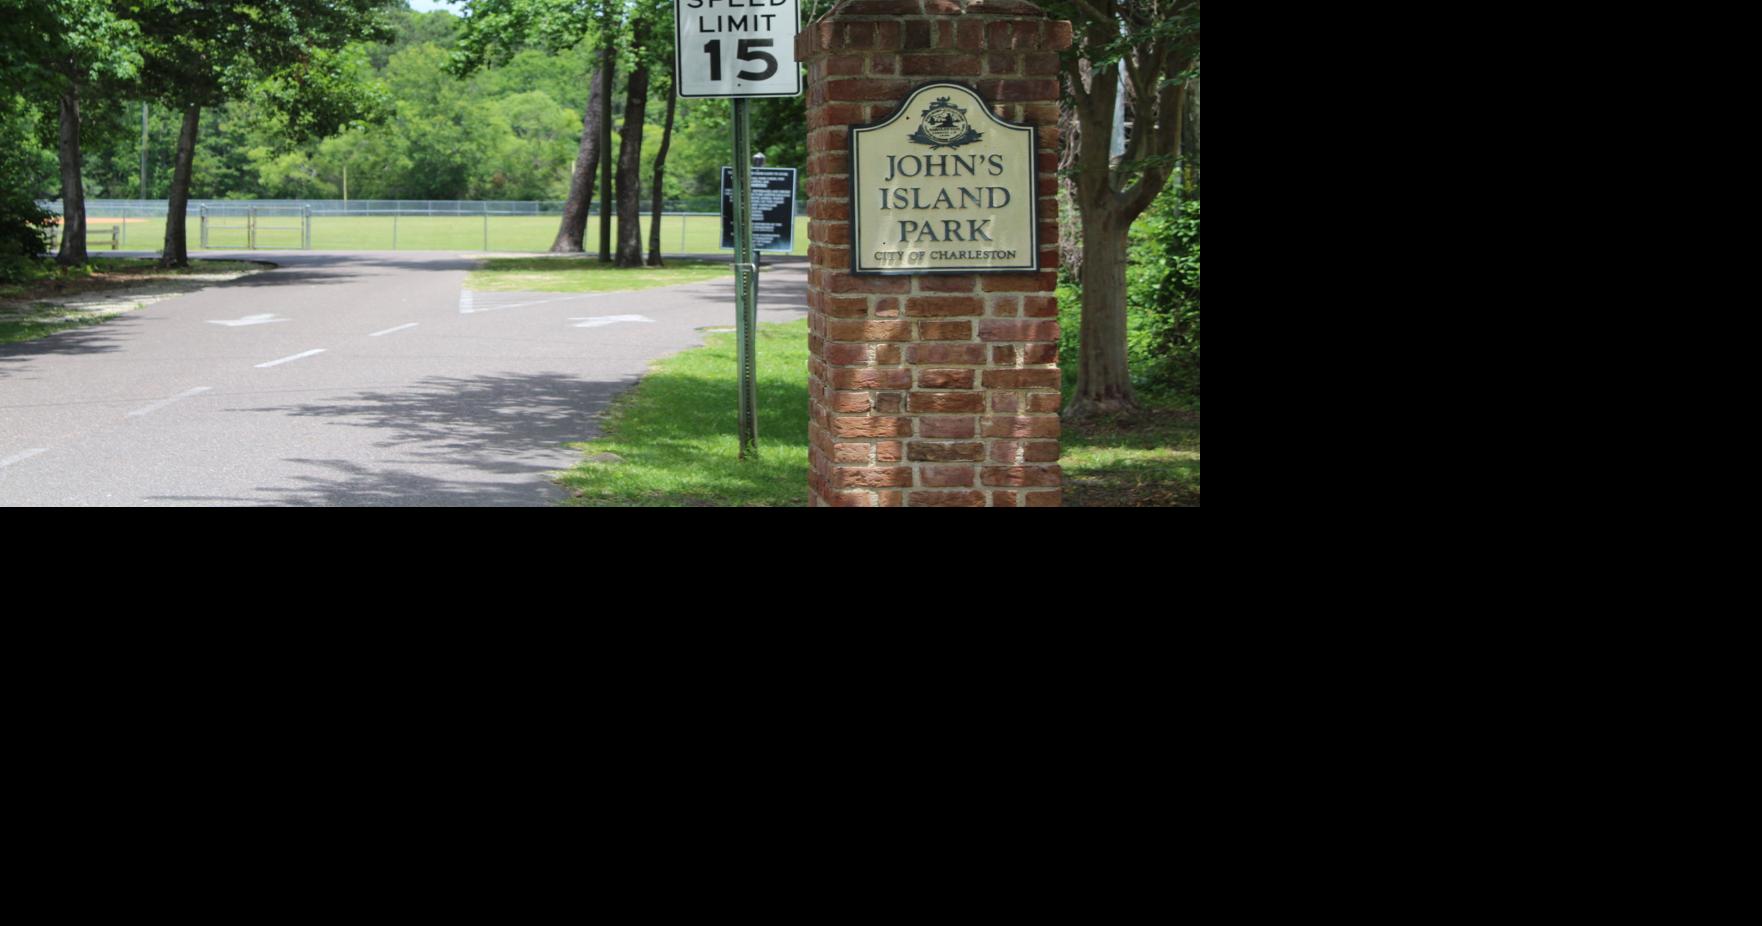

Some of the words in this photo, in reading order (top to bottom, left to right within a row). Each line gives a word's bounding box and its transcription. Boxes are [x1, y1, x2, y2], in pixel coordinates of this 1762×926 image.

[699, 14, 776, 33] LIMIT
[704, 38, 778, 81] 15
[884, 154, 1004, 182] JOHN'S
[879, 186, 1011, 210] ISLAND
[898, 219, 993, 242] PARK
[874, 251, 904, 261] CITY
[908, 251, 926, 261] OF
[930, 250, 1017, 260] CHARLESTON
